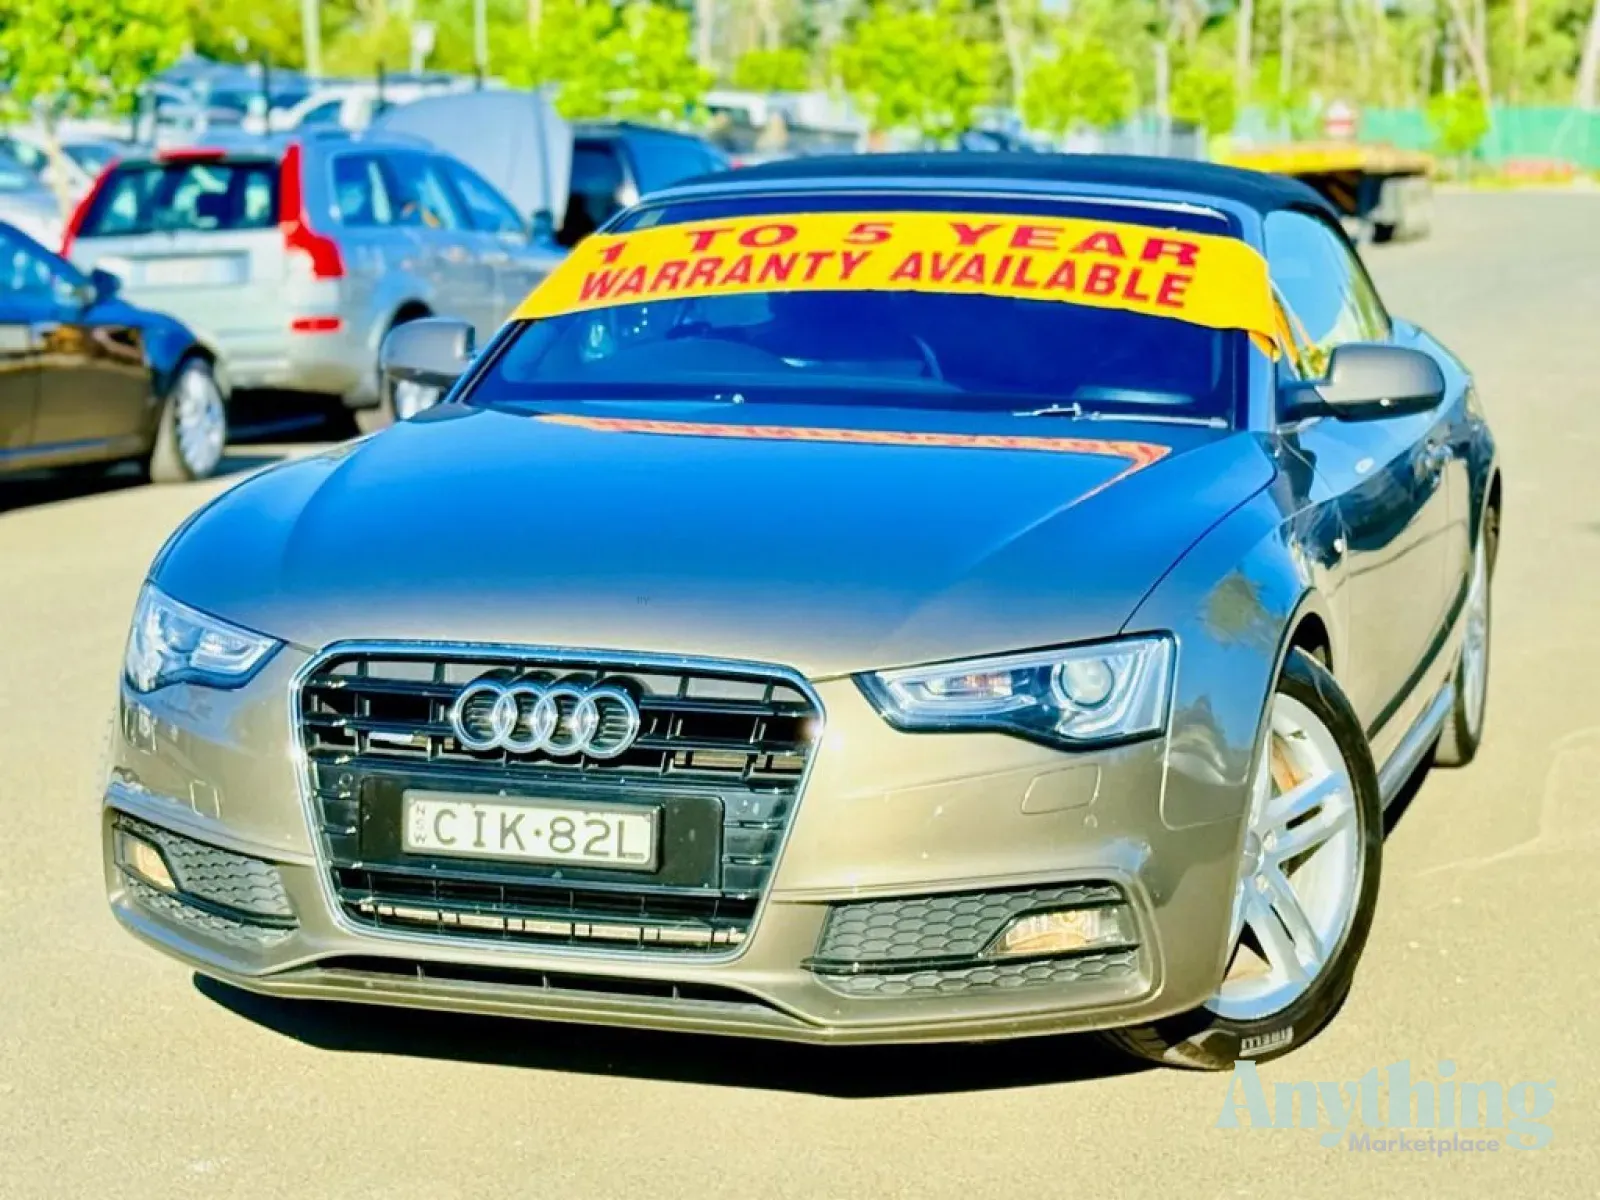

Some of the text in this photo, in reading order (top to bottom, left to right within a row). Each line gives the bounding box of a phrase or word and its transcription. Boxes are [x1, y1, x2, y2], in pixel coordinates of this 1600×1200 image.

[597, 222, 1200, 267] 1 TO 5 YEAR
[578, 251, 1193, 308] WARRANTY AVAILABLE
